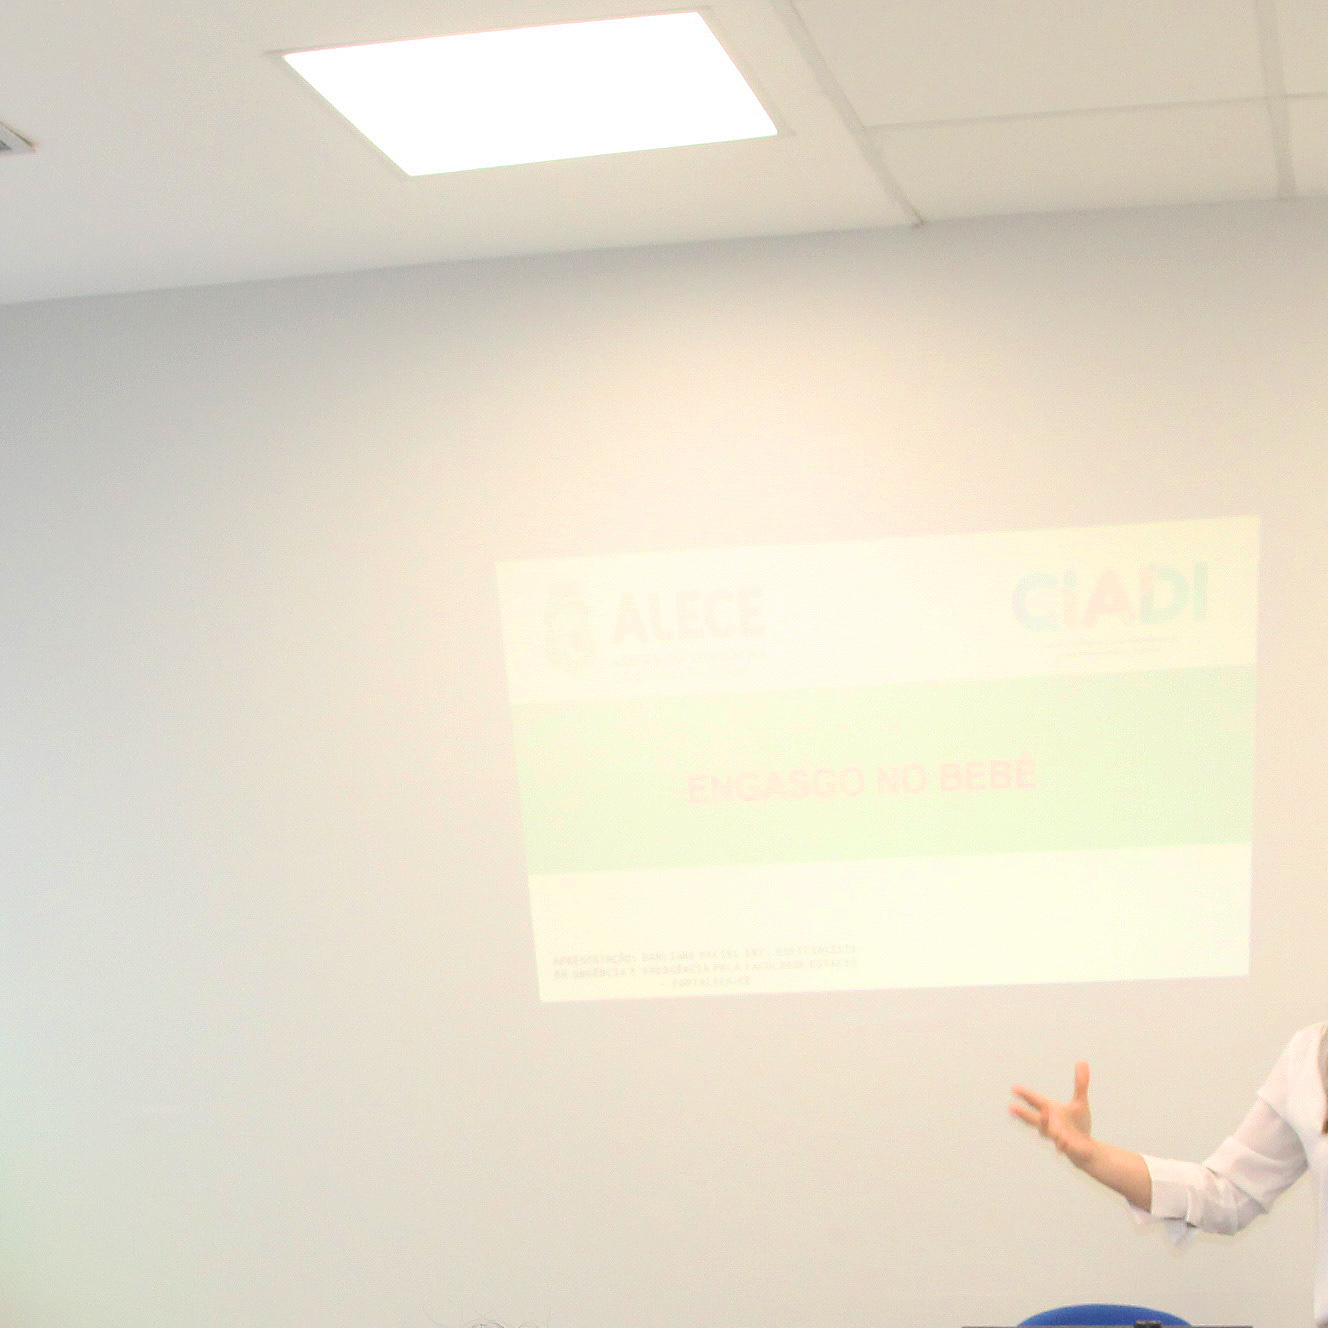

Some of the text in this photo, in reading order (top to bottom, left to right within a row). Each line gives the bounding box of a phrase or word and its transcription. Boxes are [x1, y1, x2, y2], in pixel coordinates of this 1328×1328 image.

[610, 587, 766, 644] ALECE
[687, 750, 1037, 804] ENGASGO NO BEBÊ
